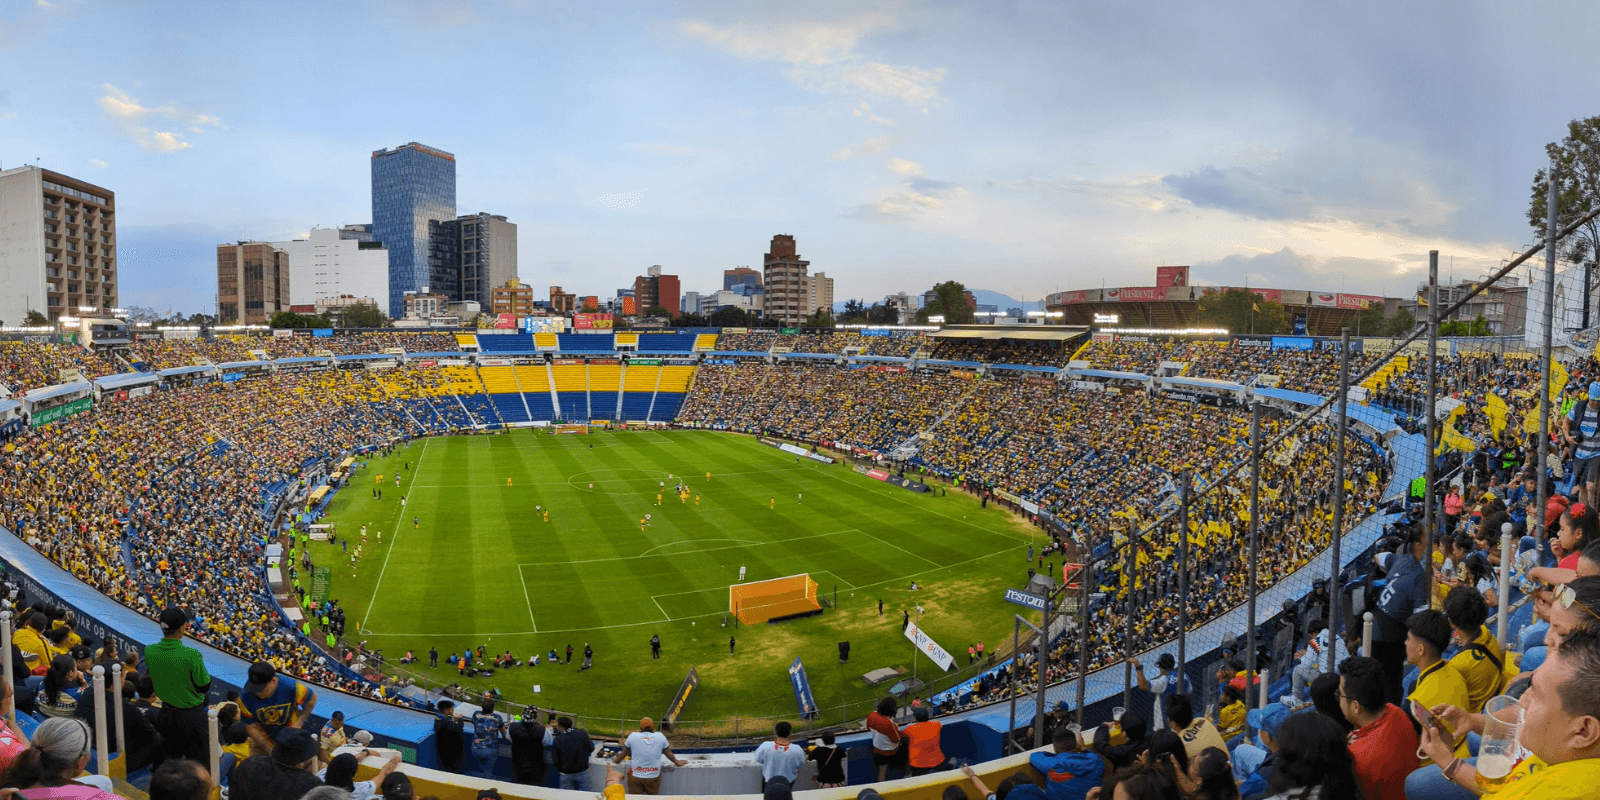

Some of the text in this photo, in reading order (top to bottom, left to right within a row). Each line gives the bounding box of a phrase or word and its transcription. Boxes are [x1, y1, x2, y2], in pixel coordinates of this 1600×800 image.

[24, 577, 55, 605] PROHIBIDO
[94, 624, 139, 653] OBETOS
[914, 631, 947, 661] GNP GNP
